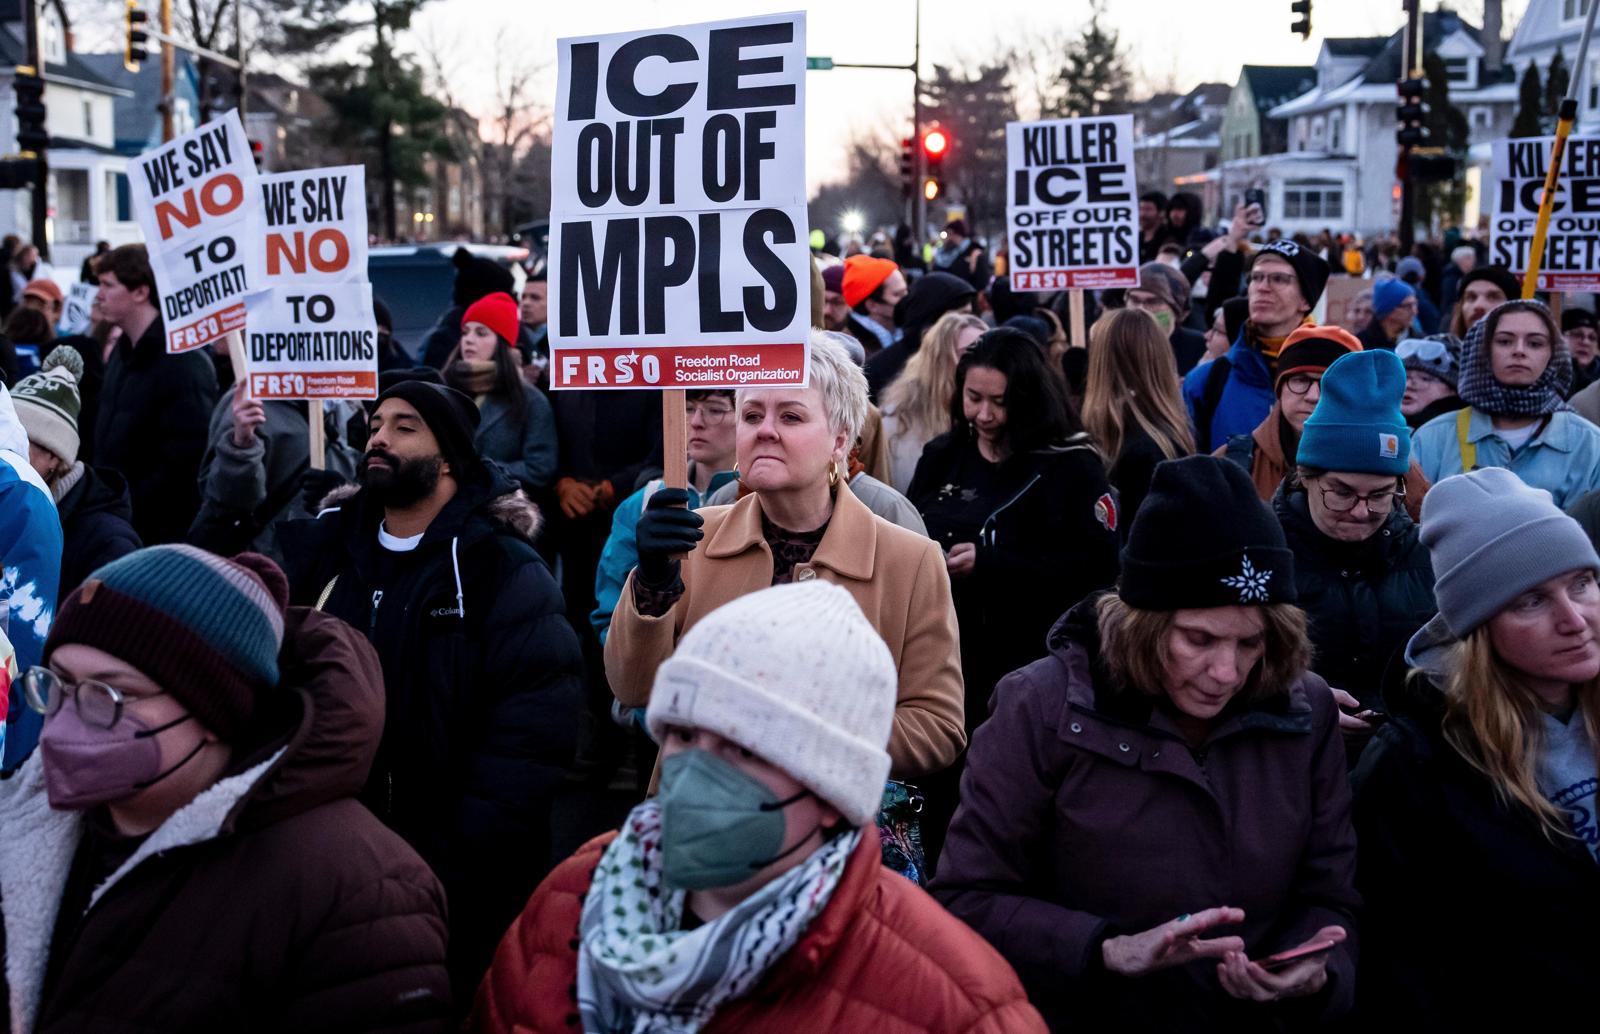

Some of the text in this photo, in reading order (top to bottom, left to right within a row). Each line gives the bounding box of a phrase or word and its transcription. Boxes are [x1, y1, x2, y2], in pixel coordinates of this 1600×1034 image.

[568, 22, 796, 121] ICE
[142, 124, 232, 198] WE SAY
[577, 110, 777, 208] OUT OF
[1023, 122, 1117, 167] KILLER
[262, 176, 347, 227] WE SAY
[1015, 164, 1131, 206] ICE
[1500, 180, 1600, 214] ICE
[154, 172, 244, 241] NO
[1014, 207, 1131, 227] OFF OUR
[1498, 217, 1600, 232] OF OU
[184, 235, 237, 274] TO
[266, 228, 350, 276] NO
[1014, 225, 1133, 268] STREETS
[1495, 234, 1600, 270] STEET
[559, 208, 797, 337] MPLS
[165, 264, 248, 322] DEPORTATI
[286, 294, 335, 324] TO
[251, 330, 374, 362] DEPORTATIONS
[675, 354, 760, 369] Freedom Road
[253, 373, 305, 395] FRSO
[562, 350, 661, 384] FRSO
[675, 367, 799, 384] Socialist Organization
